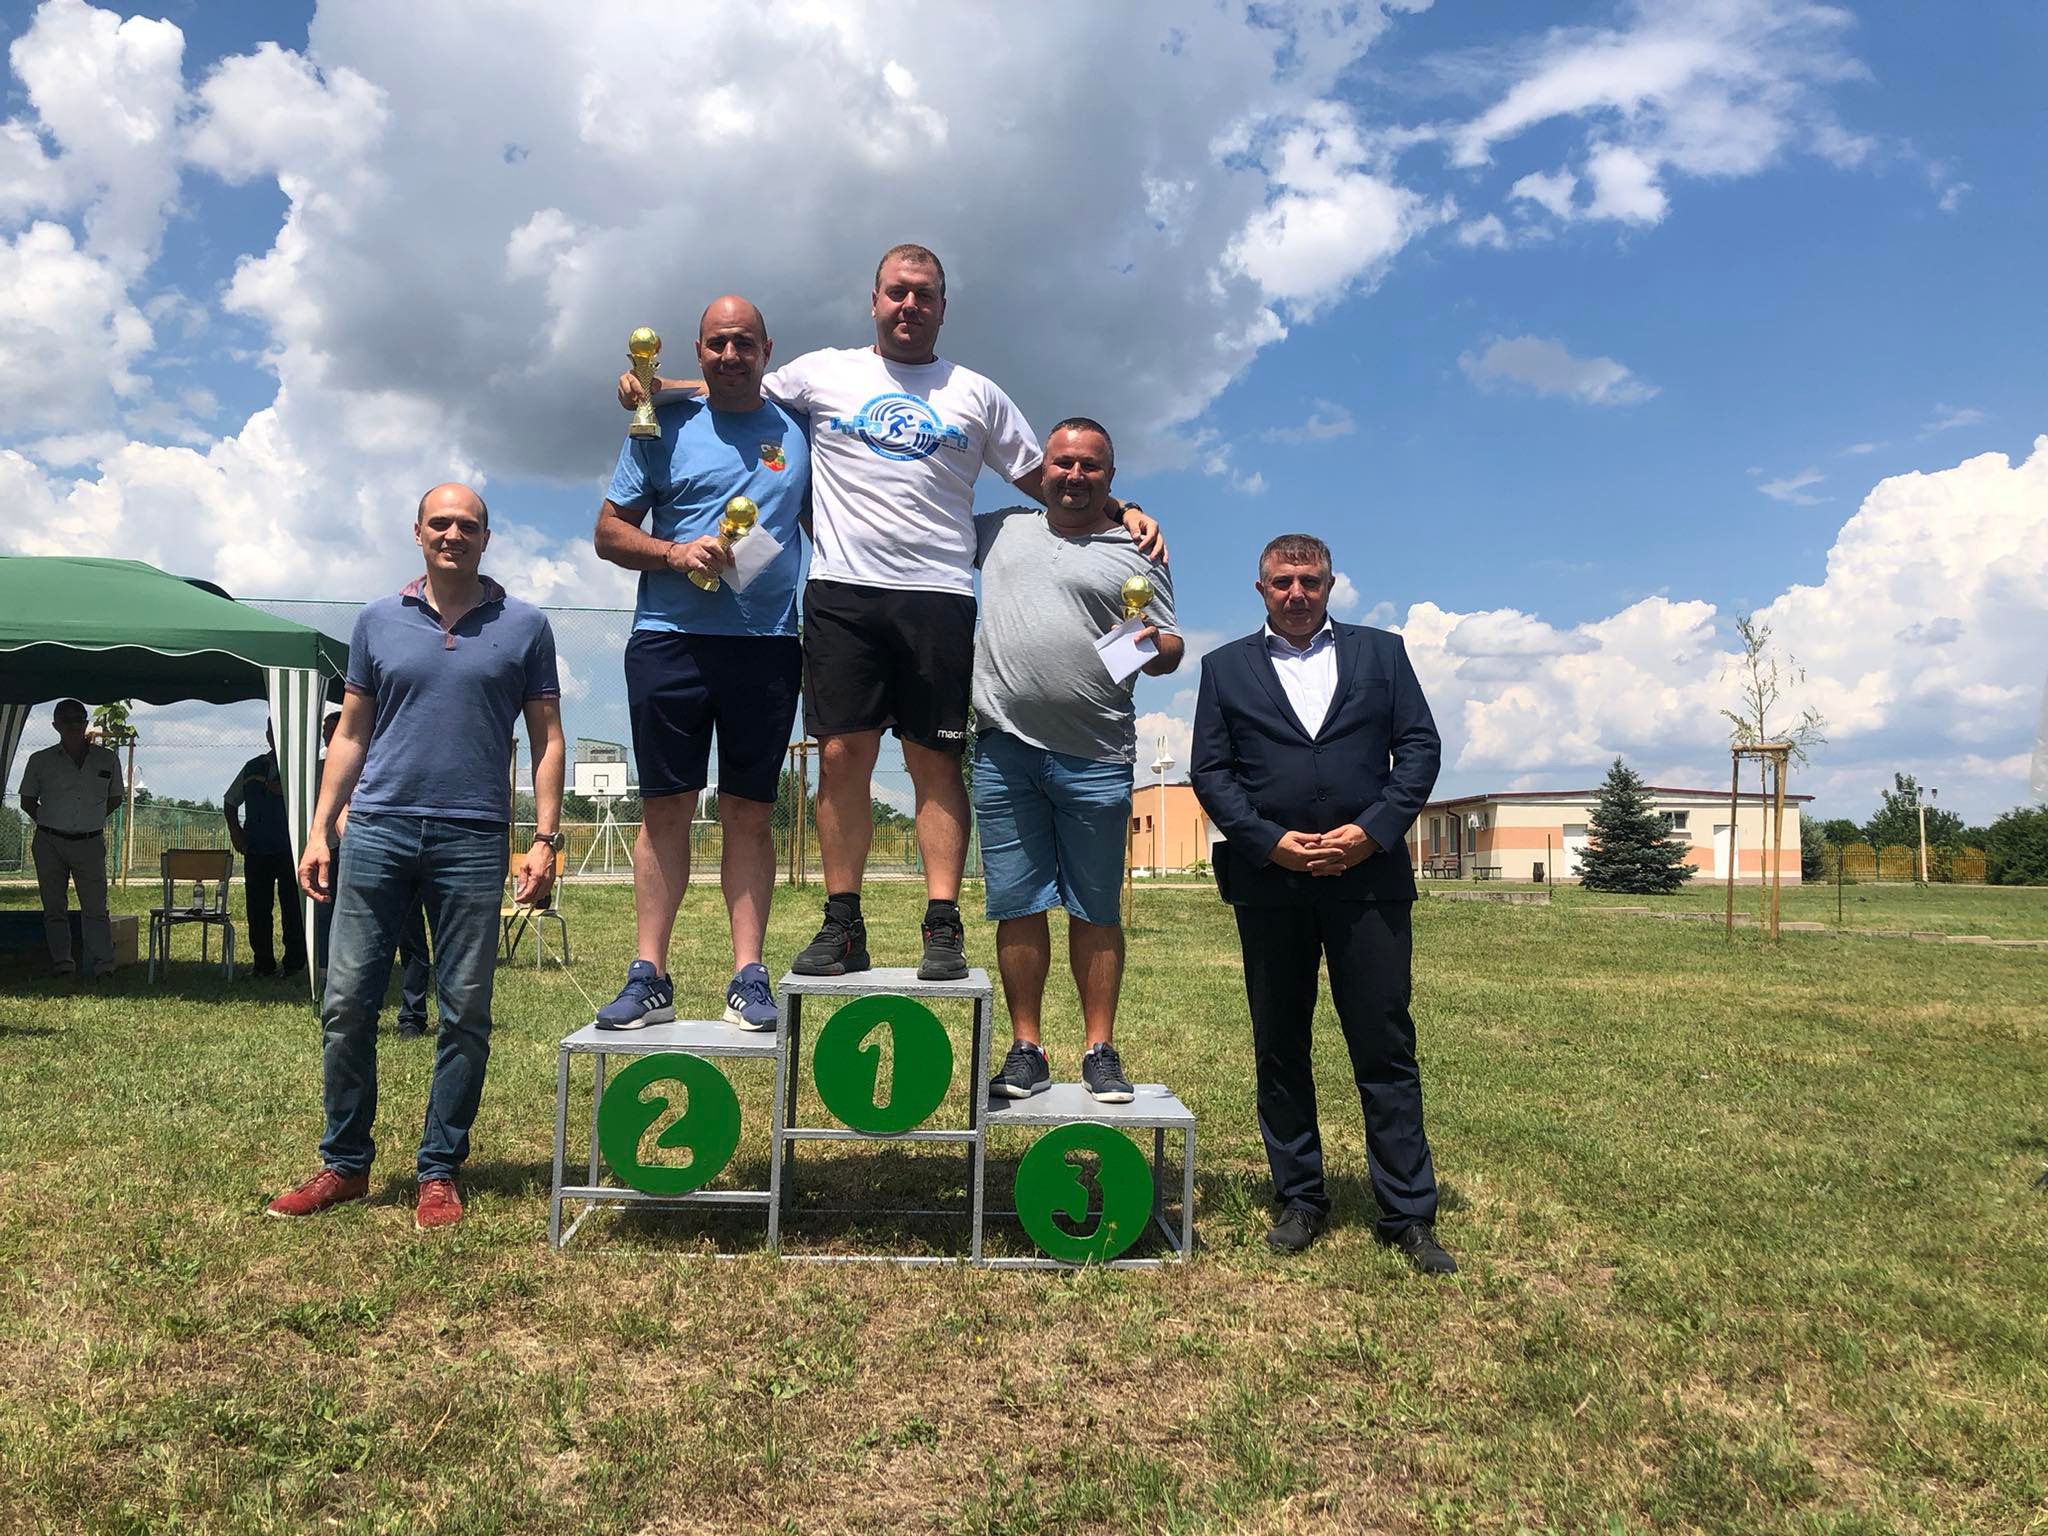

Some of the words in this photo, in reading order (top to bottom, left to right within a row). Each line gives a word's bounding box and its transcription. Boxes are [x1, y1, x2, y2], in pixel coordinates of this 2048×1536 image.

[859, 1021, 894, 1108] 1
[636, 1078, 694, 1168] 2
[1051, 1148, 1104, 1239] 3
